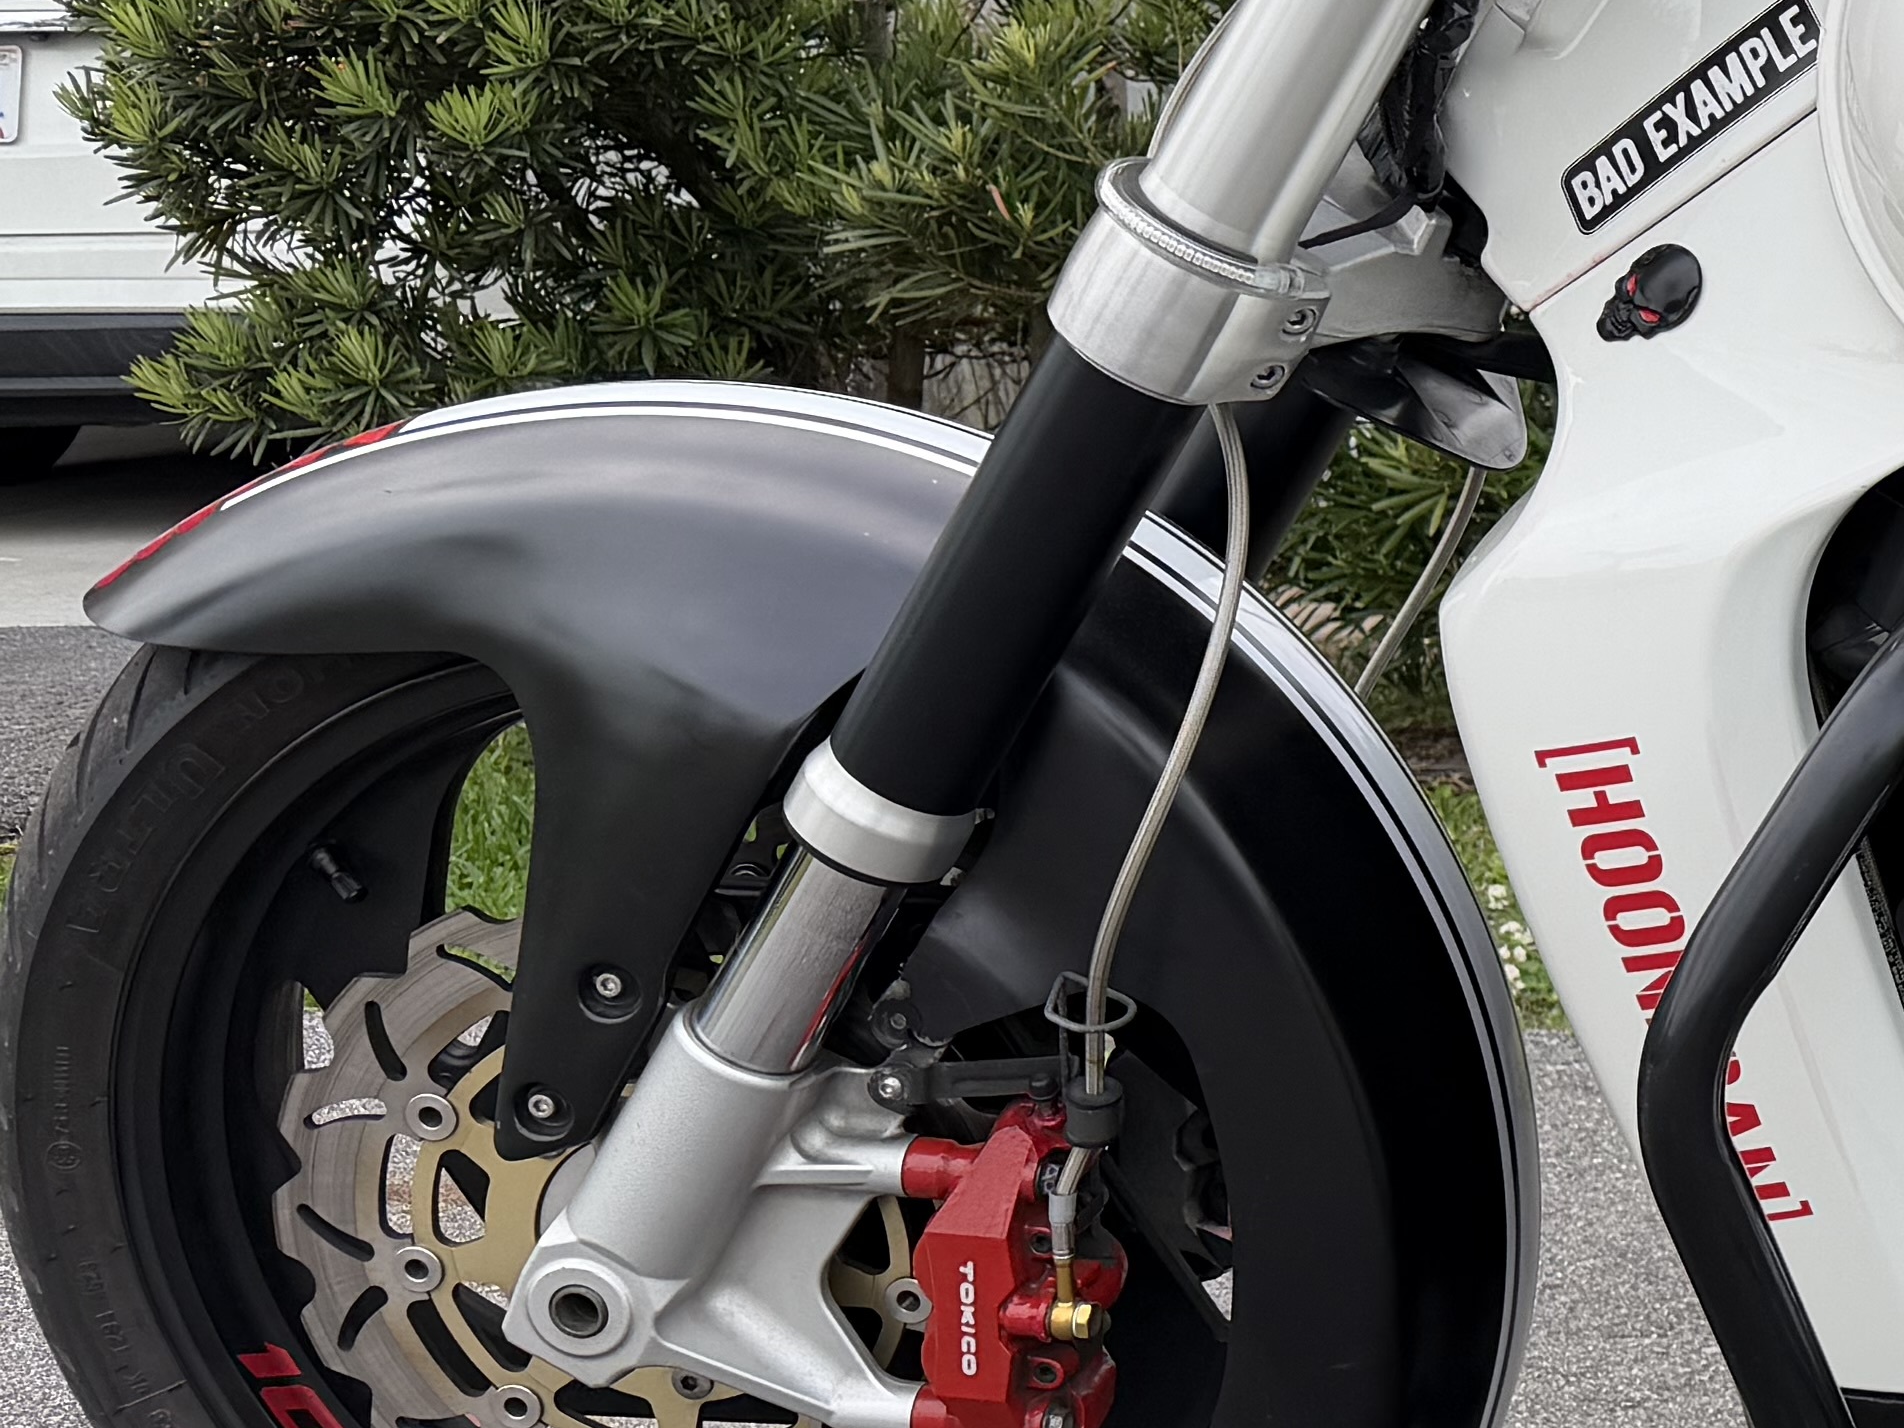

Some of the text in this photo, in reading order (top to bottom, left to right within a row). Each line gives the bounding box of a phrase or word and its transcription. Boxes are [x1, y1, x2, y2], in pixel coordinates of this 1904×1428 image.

[1571, 4, 1818, 220] BAD EXAMPLE
[959, 1260, 977, 1376] TOKICO
